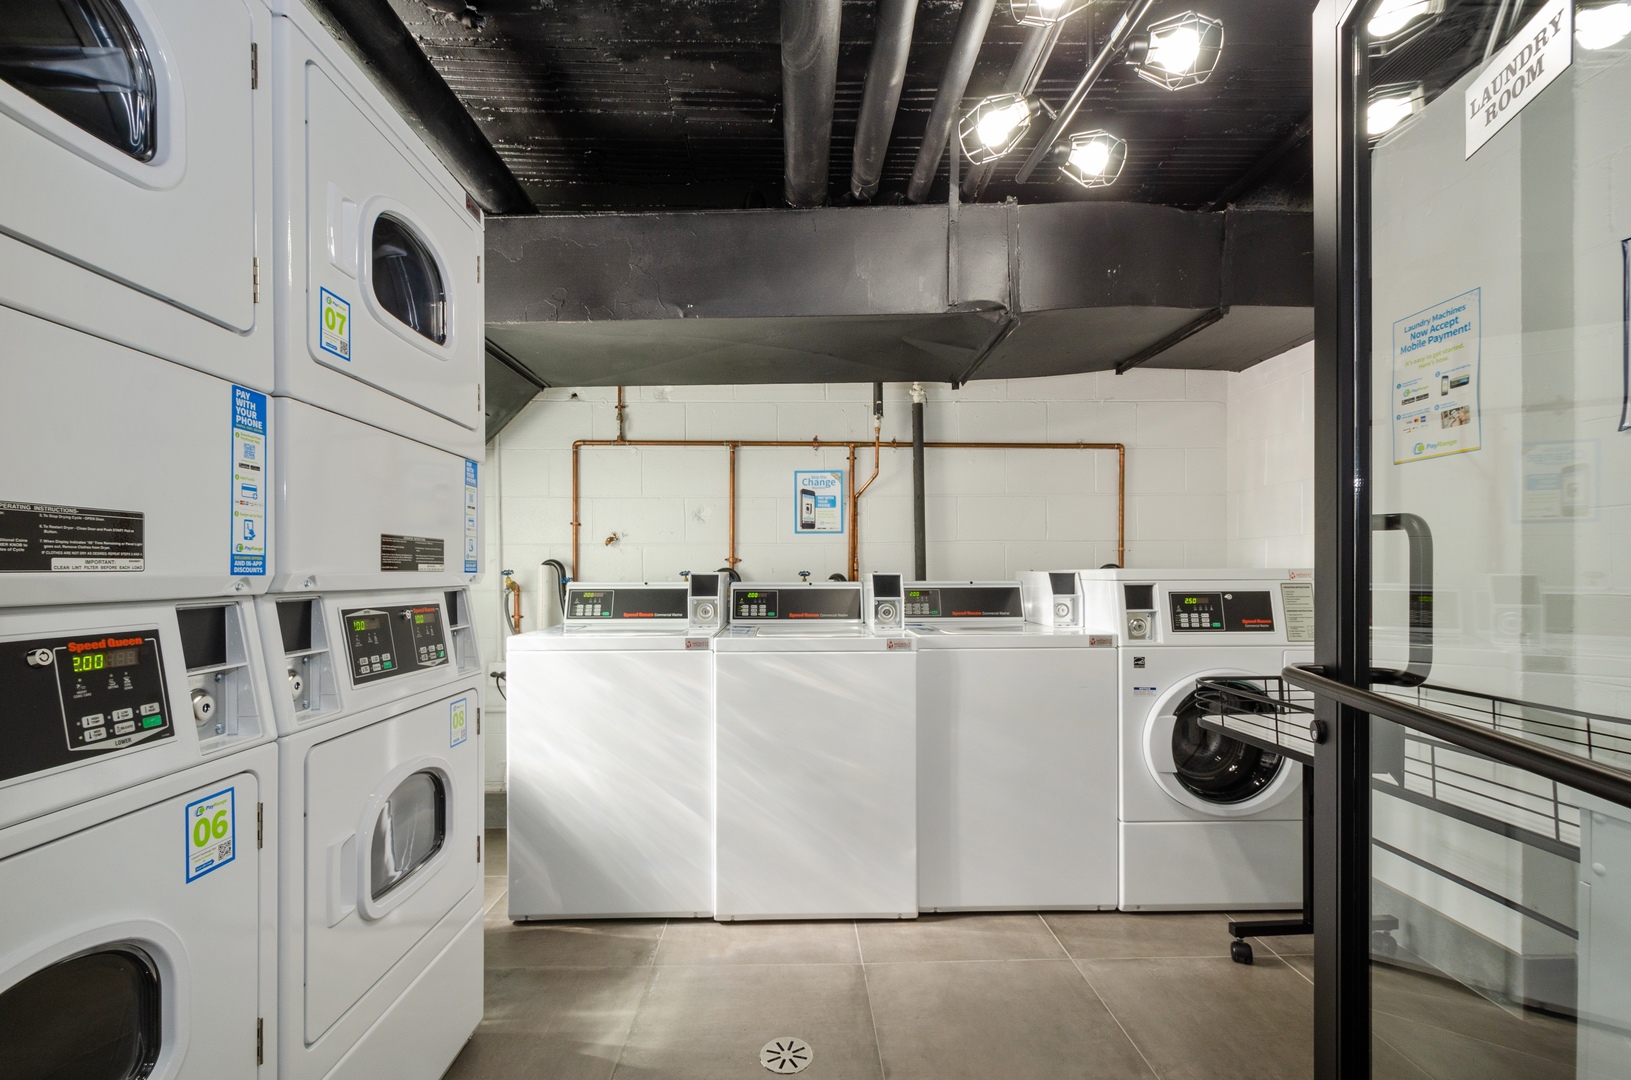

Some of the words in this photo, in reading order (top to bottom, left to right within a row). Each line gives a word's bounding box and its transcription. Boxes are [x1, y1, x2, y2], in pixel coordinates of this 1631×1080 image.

[1469, 7, 1565, 119] LAUNDRY
[1484, 53, 1545, 127] ROOM
[325, 306, 346, 335] 07
[1404, 318, 1431, 333] Laundry
[1432, 304, 1466, 322] Machines
[1410, 329, 1428, 340] Now
[1430, 316, 1459, 334] Accept
[1400, 340, 1427, 354] Mobile
[1428, 322, 1471, 344] Payment!
[1414, 357, 1425, 365] easy
[236, 388, 250, 400] PAY
[236, 397, 256, 410] WITH
[236, 406, 257, 420] YOUR
[236, 414, 263, 430] PHONE
[1426, 440, 1457, 450] PayRange
[802, 478, 836, 488] Change
[68, 640, 106, 652] Speed
[107, 637, 142, 647] Queen
[452, 710, 464, 729] 08
[115, 738, 132, 746] LOWER
[206, 798, 228, 811] PayRange
[193, 810, 228, 848] 06
